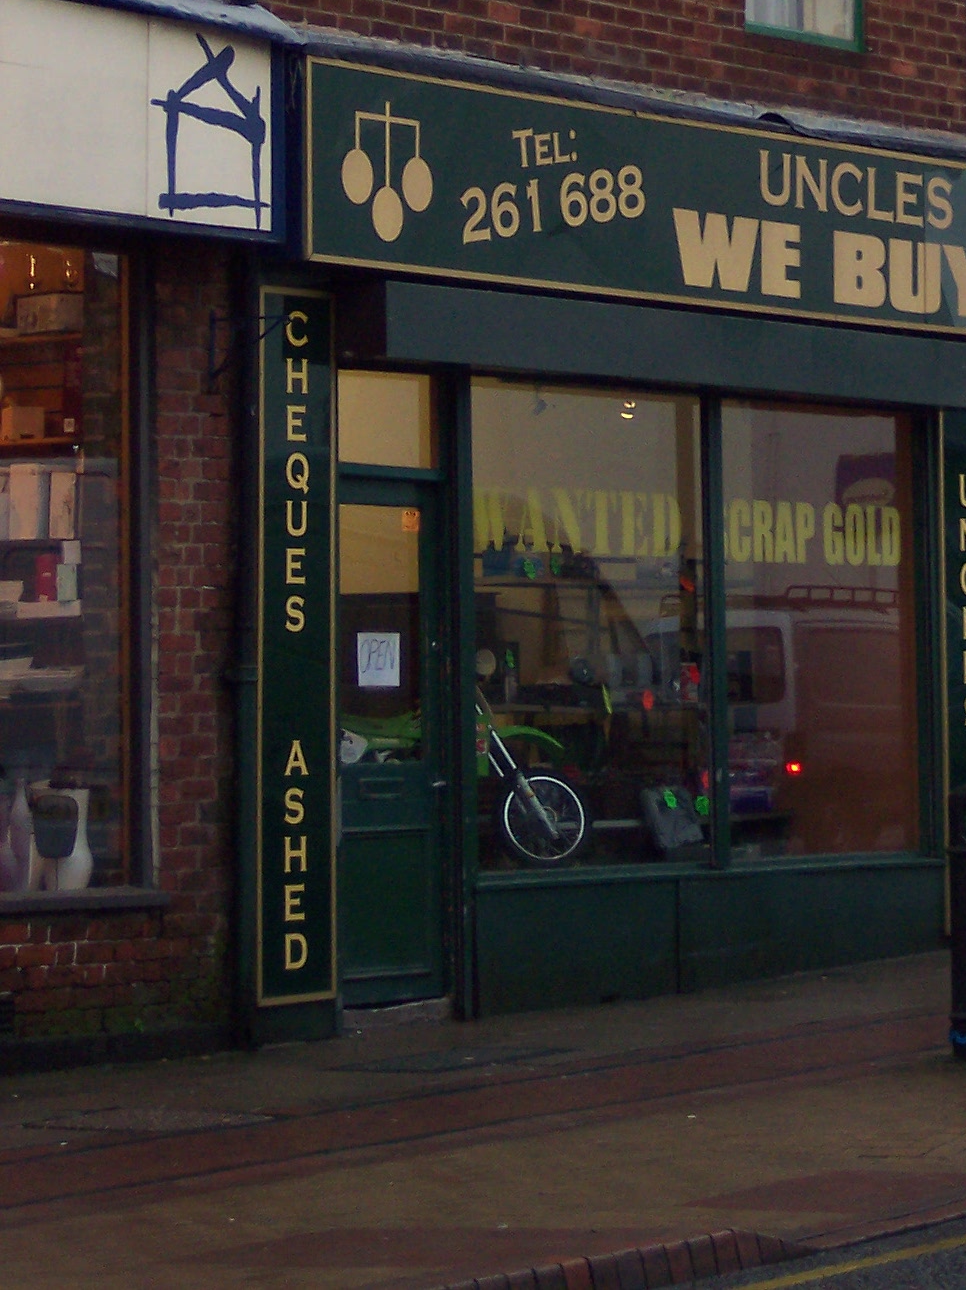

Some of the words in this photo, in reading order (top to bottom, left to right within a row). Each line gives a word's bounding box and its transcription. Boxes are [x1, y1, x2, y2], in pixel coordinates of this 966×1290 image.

[511, 128, 578, 169] TEL:
[460, 178, 542, 245] 261
[560, 164, 647, 228] 688
[758, 149, 954, 230] UNCLES
[673, 207, 801, 300] WE
[284, 311, 311, 633] CHEQUES
[472, 487, 682, 557] WANTED
[725, 498, 816, 565] CRAP
[822, 501, 901, 567] GOLD
[360, 637, 396, 673] OPEN
